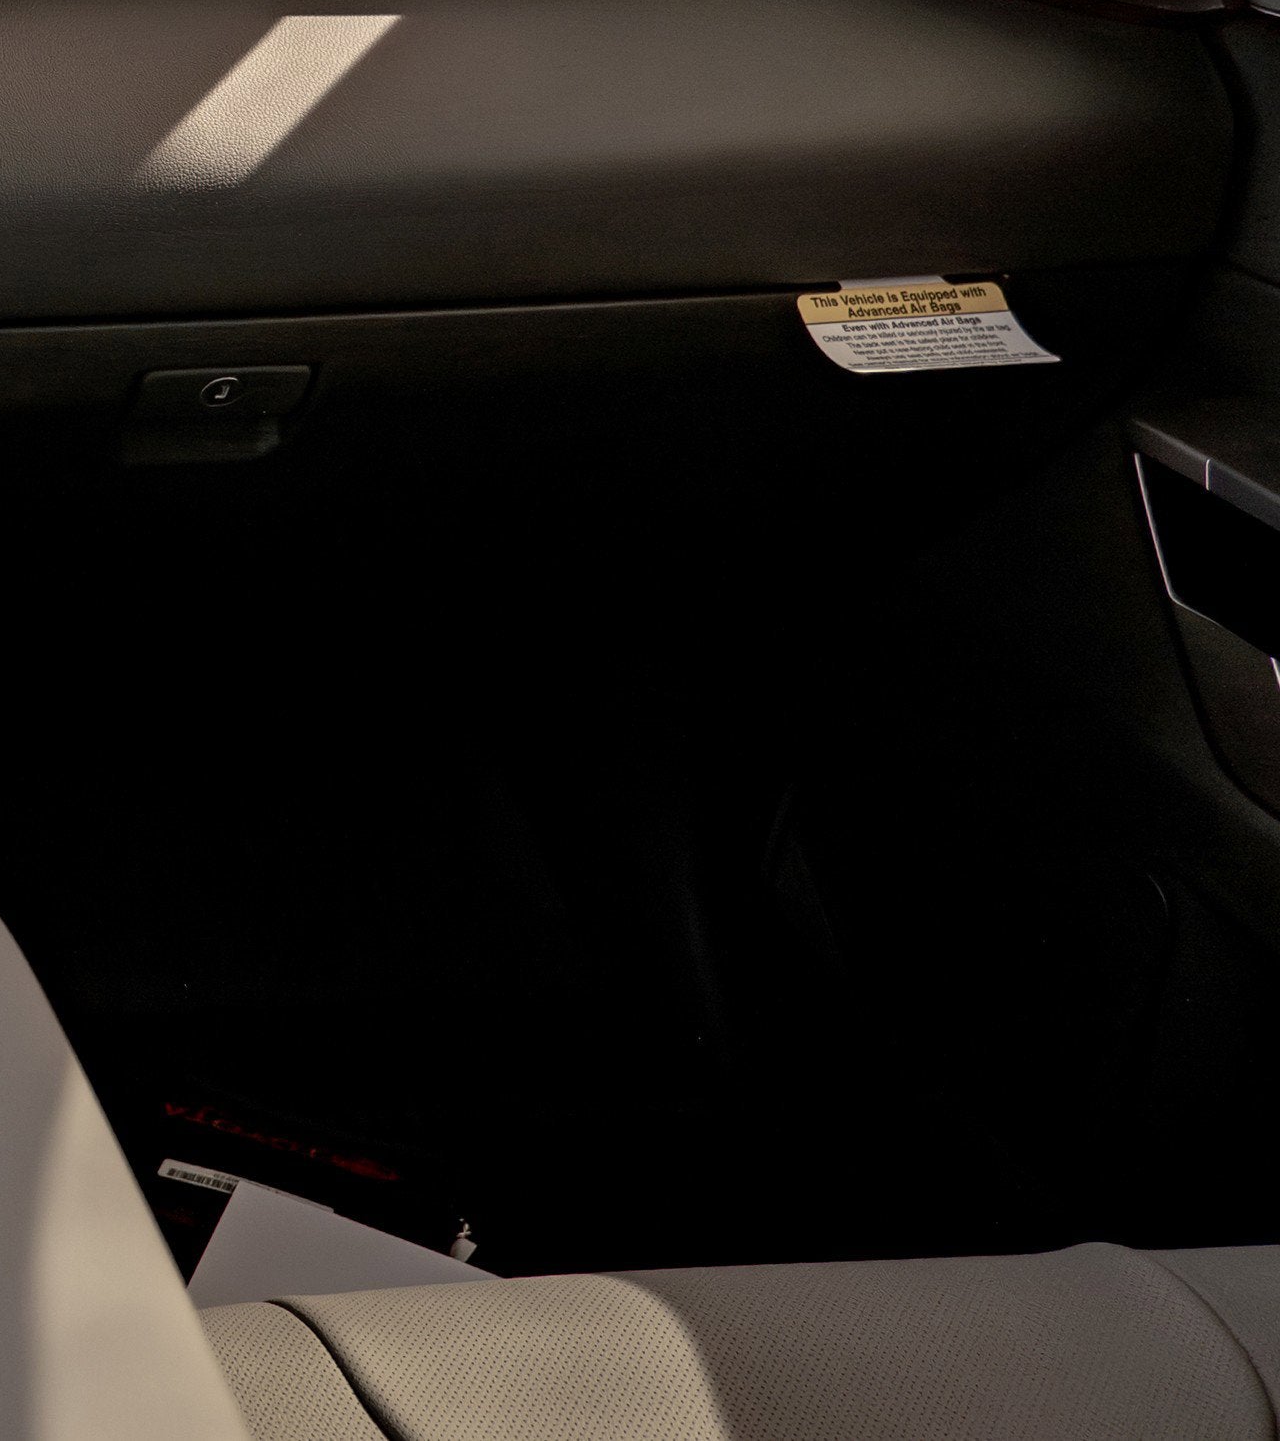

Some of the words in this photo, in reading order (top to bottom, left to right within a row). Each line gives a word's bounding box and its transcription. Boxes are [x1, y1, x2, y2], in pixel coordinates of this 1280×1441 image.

[810, 296, 838, 309] This
[840, 293, 884, 307] Vehicle
[887, 291, 898, 303] is
[902, 288, 958, 306] Equipped
[960, 286, 987, 299] with
[847, 304, 908, 319] Advanced
[910, 302, 928, 314] Air
[929, 301, 962, 314] Bags
